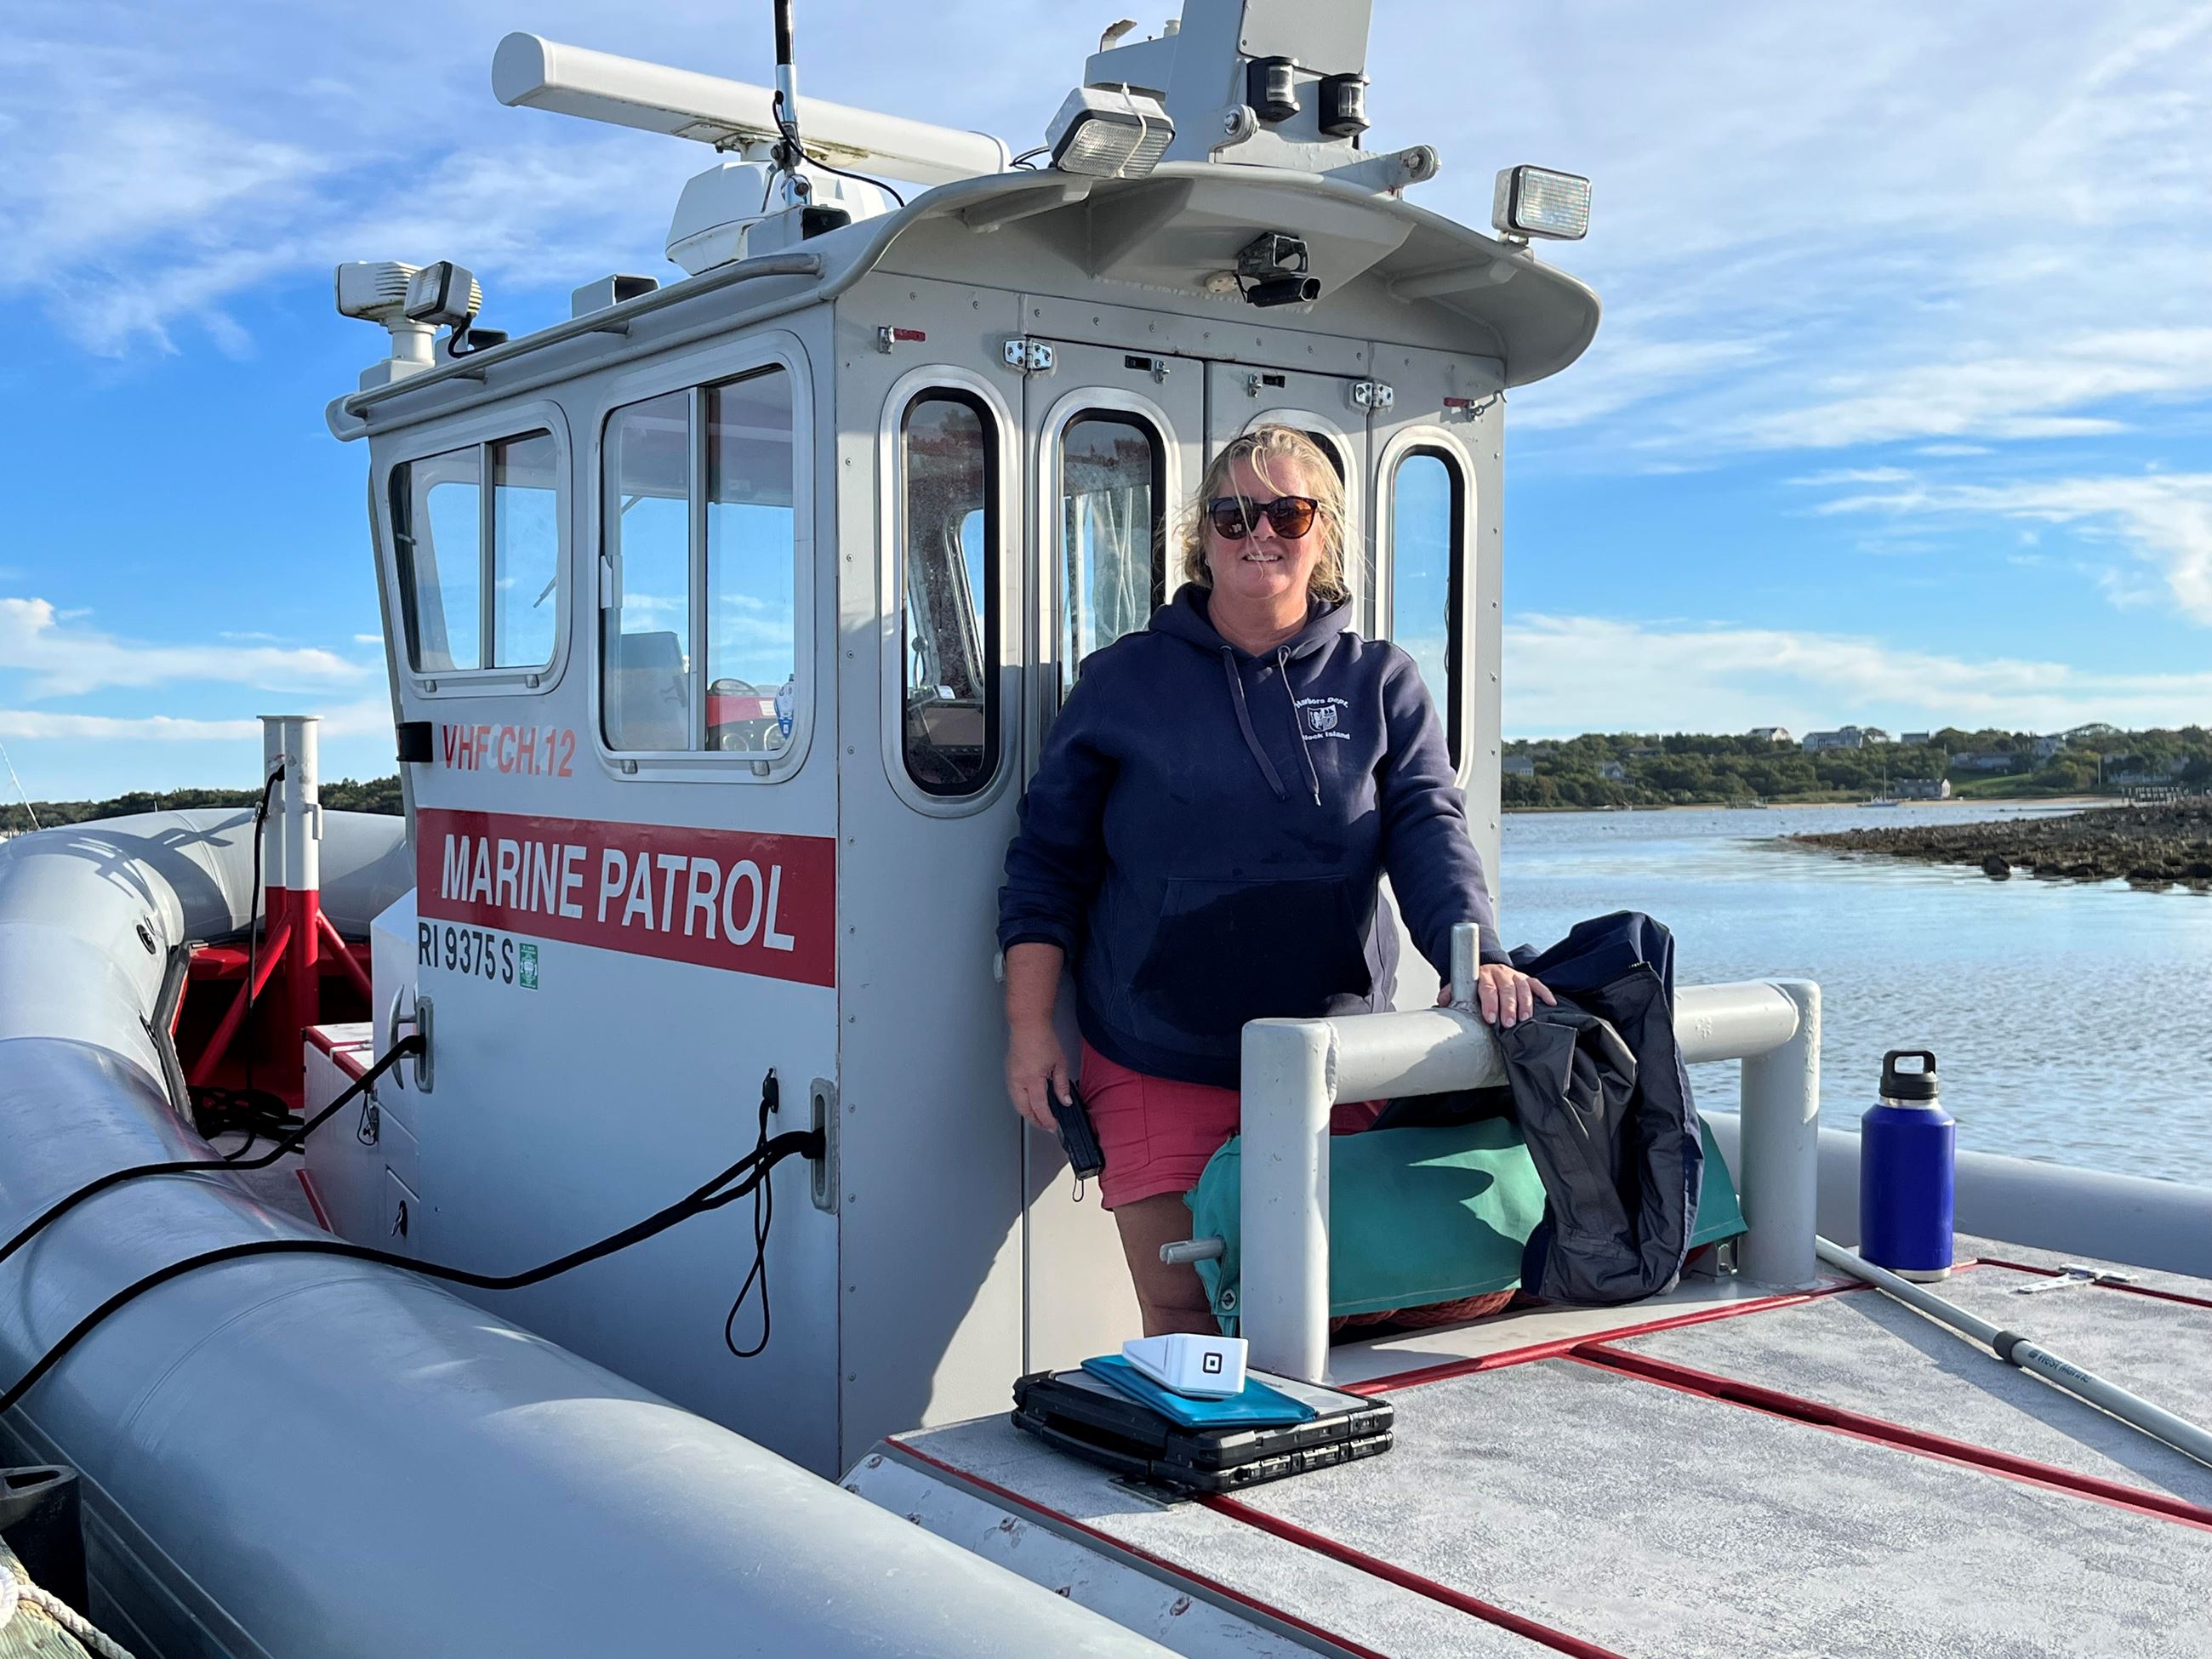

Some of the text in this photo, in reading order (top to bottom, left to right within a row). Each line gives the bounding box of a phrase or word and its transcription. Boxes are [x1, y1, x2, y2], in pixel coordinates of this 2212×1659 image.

[442, 725, 491, 771] VHF
[1325, 731, 1350, 740] Island
[441, 834, 795, 952] MARINE PATROL
[419, 921, 514, 984] RI 9375 S
